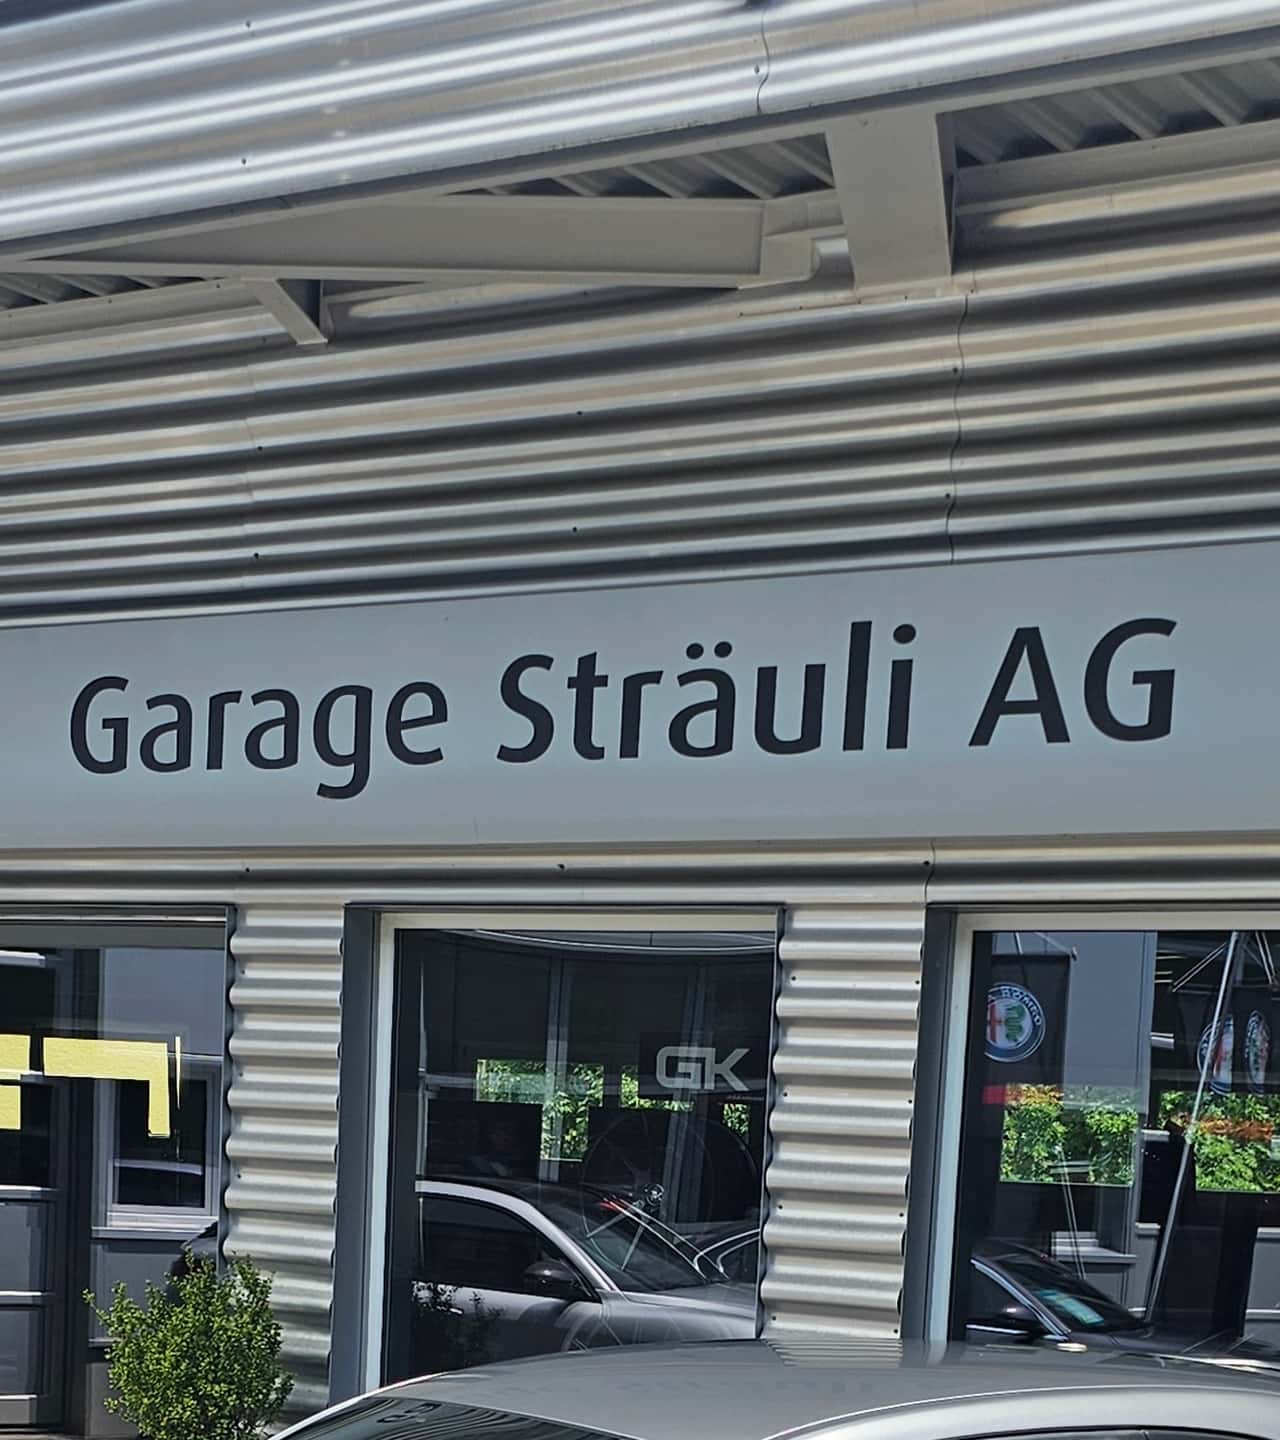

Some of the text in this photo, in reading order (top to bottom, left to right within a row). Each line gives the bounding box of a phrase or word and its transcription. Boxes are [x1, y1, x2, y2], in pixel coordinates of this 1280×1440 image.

[69, 617, 1178, 800] Garage Sträuli AG
[656, 1046, 750, 1092] GK
